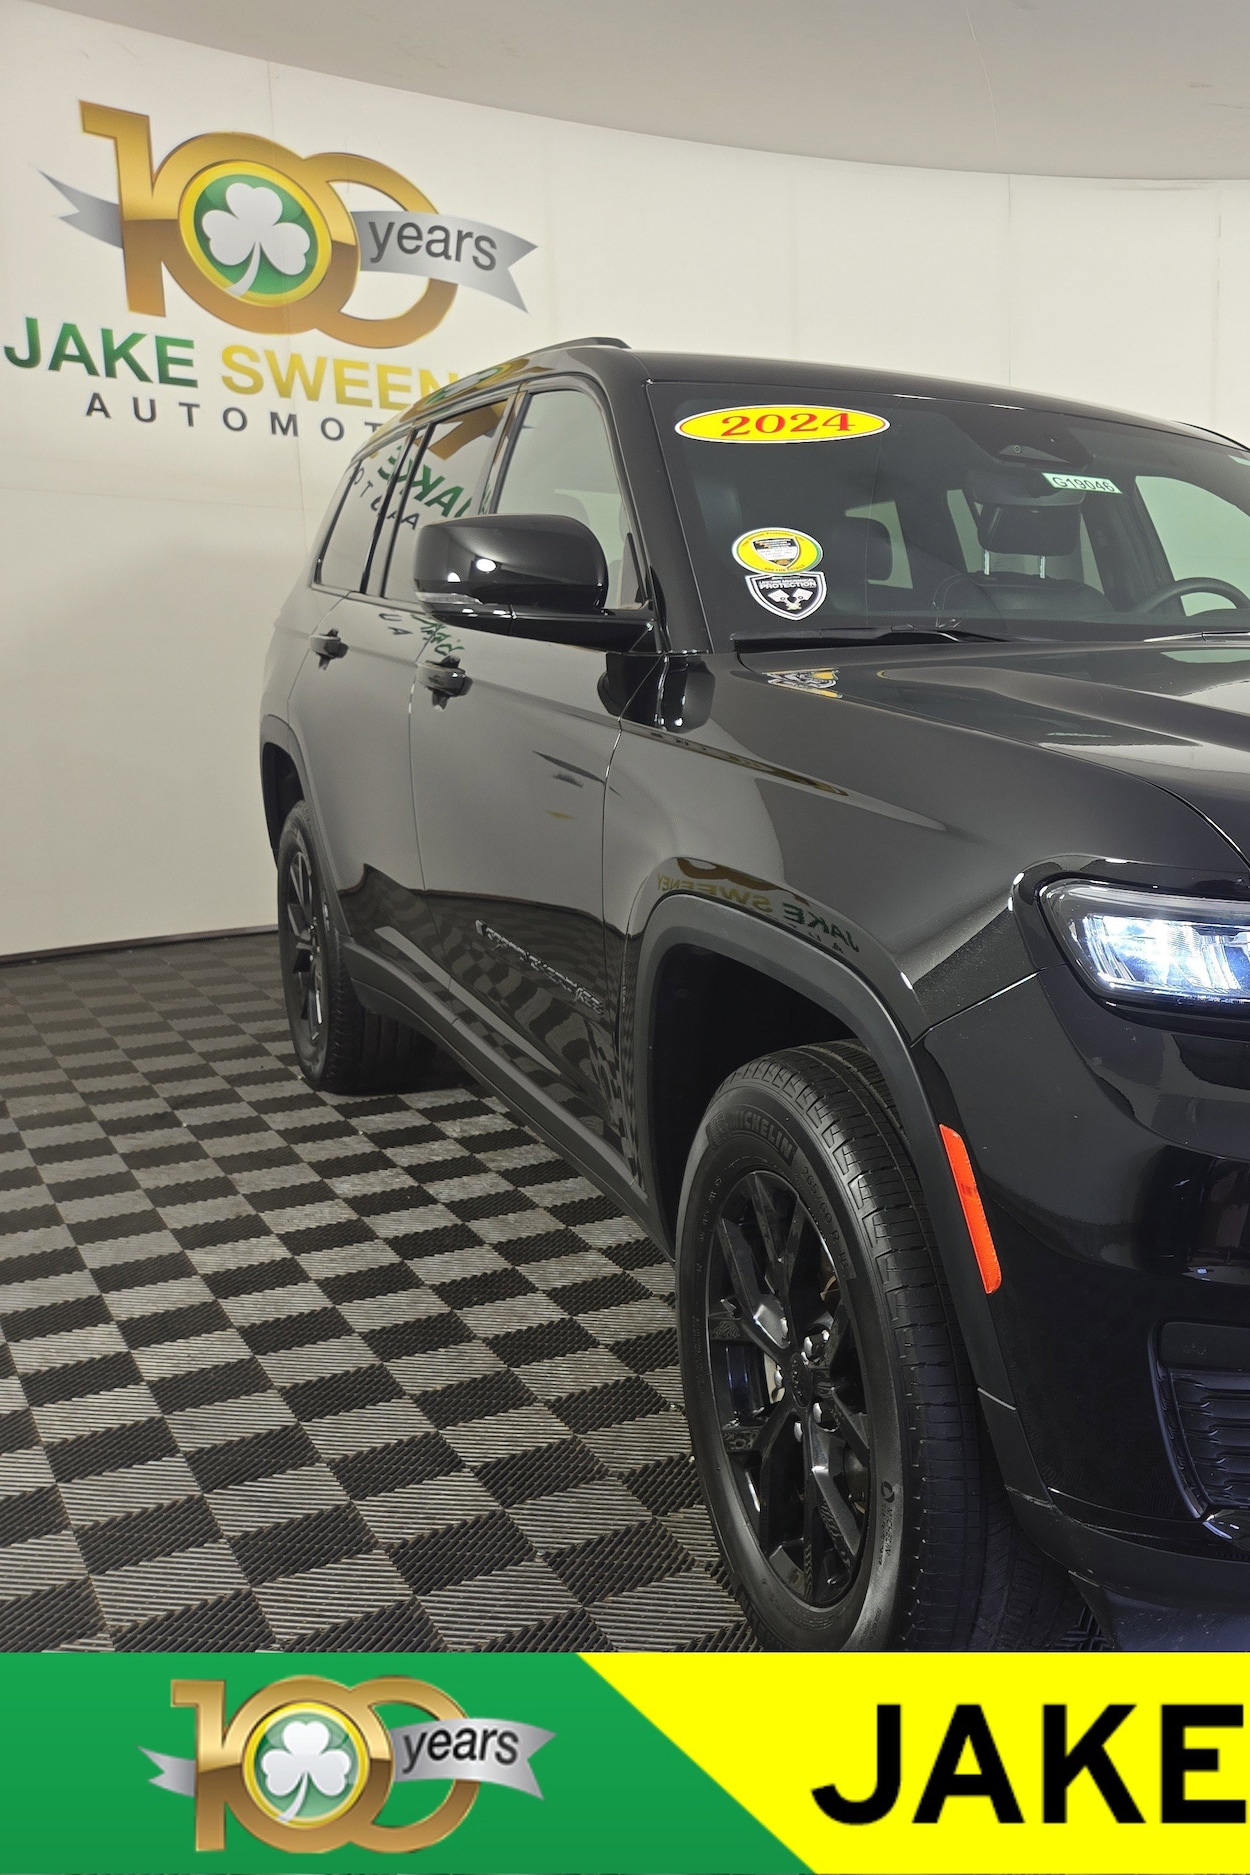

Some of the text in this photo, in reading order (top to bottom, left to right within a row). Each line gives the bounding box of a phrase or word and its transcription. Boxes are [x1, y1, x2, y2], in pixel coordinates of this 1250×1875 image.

[368, 221, 498, 273] years
[3, 316, 198, 388] JAKE
[720, 412, 856, 437] 2024
[1052, 476, 1116, 493] G19046
[759, 579, 817, 590] PROTECTION
[733, 1110, 803, 1162] MICHELIN
